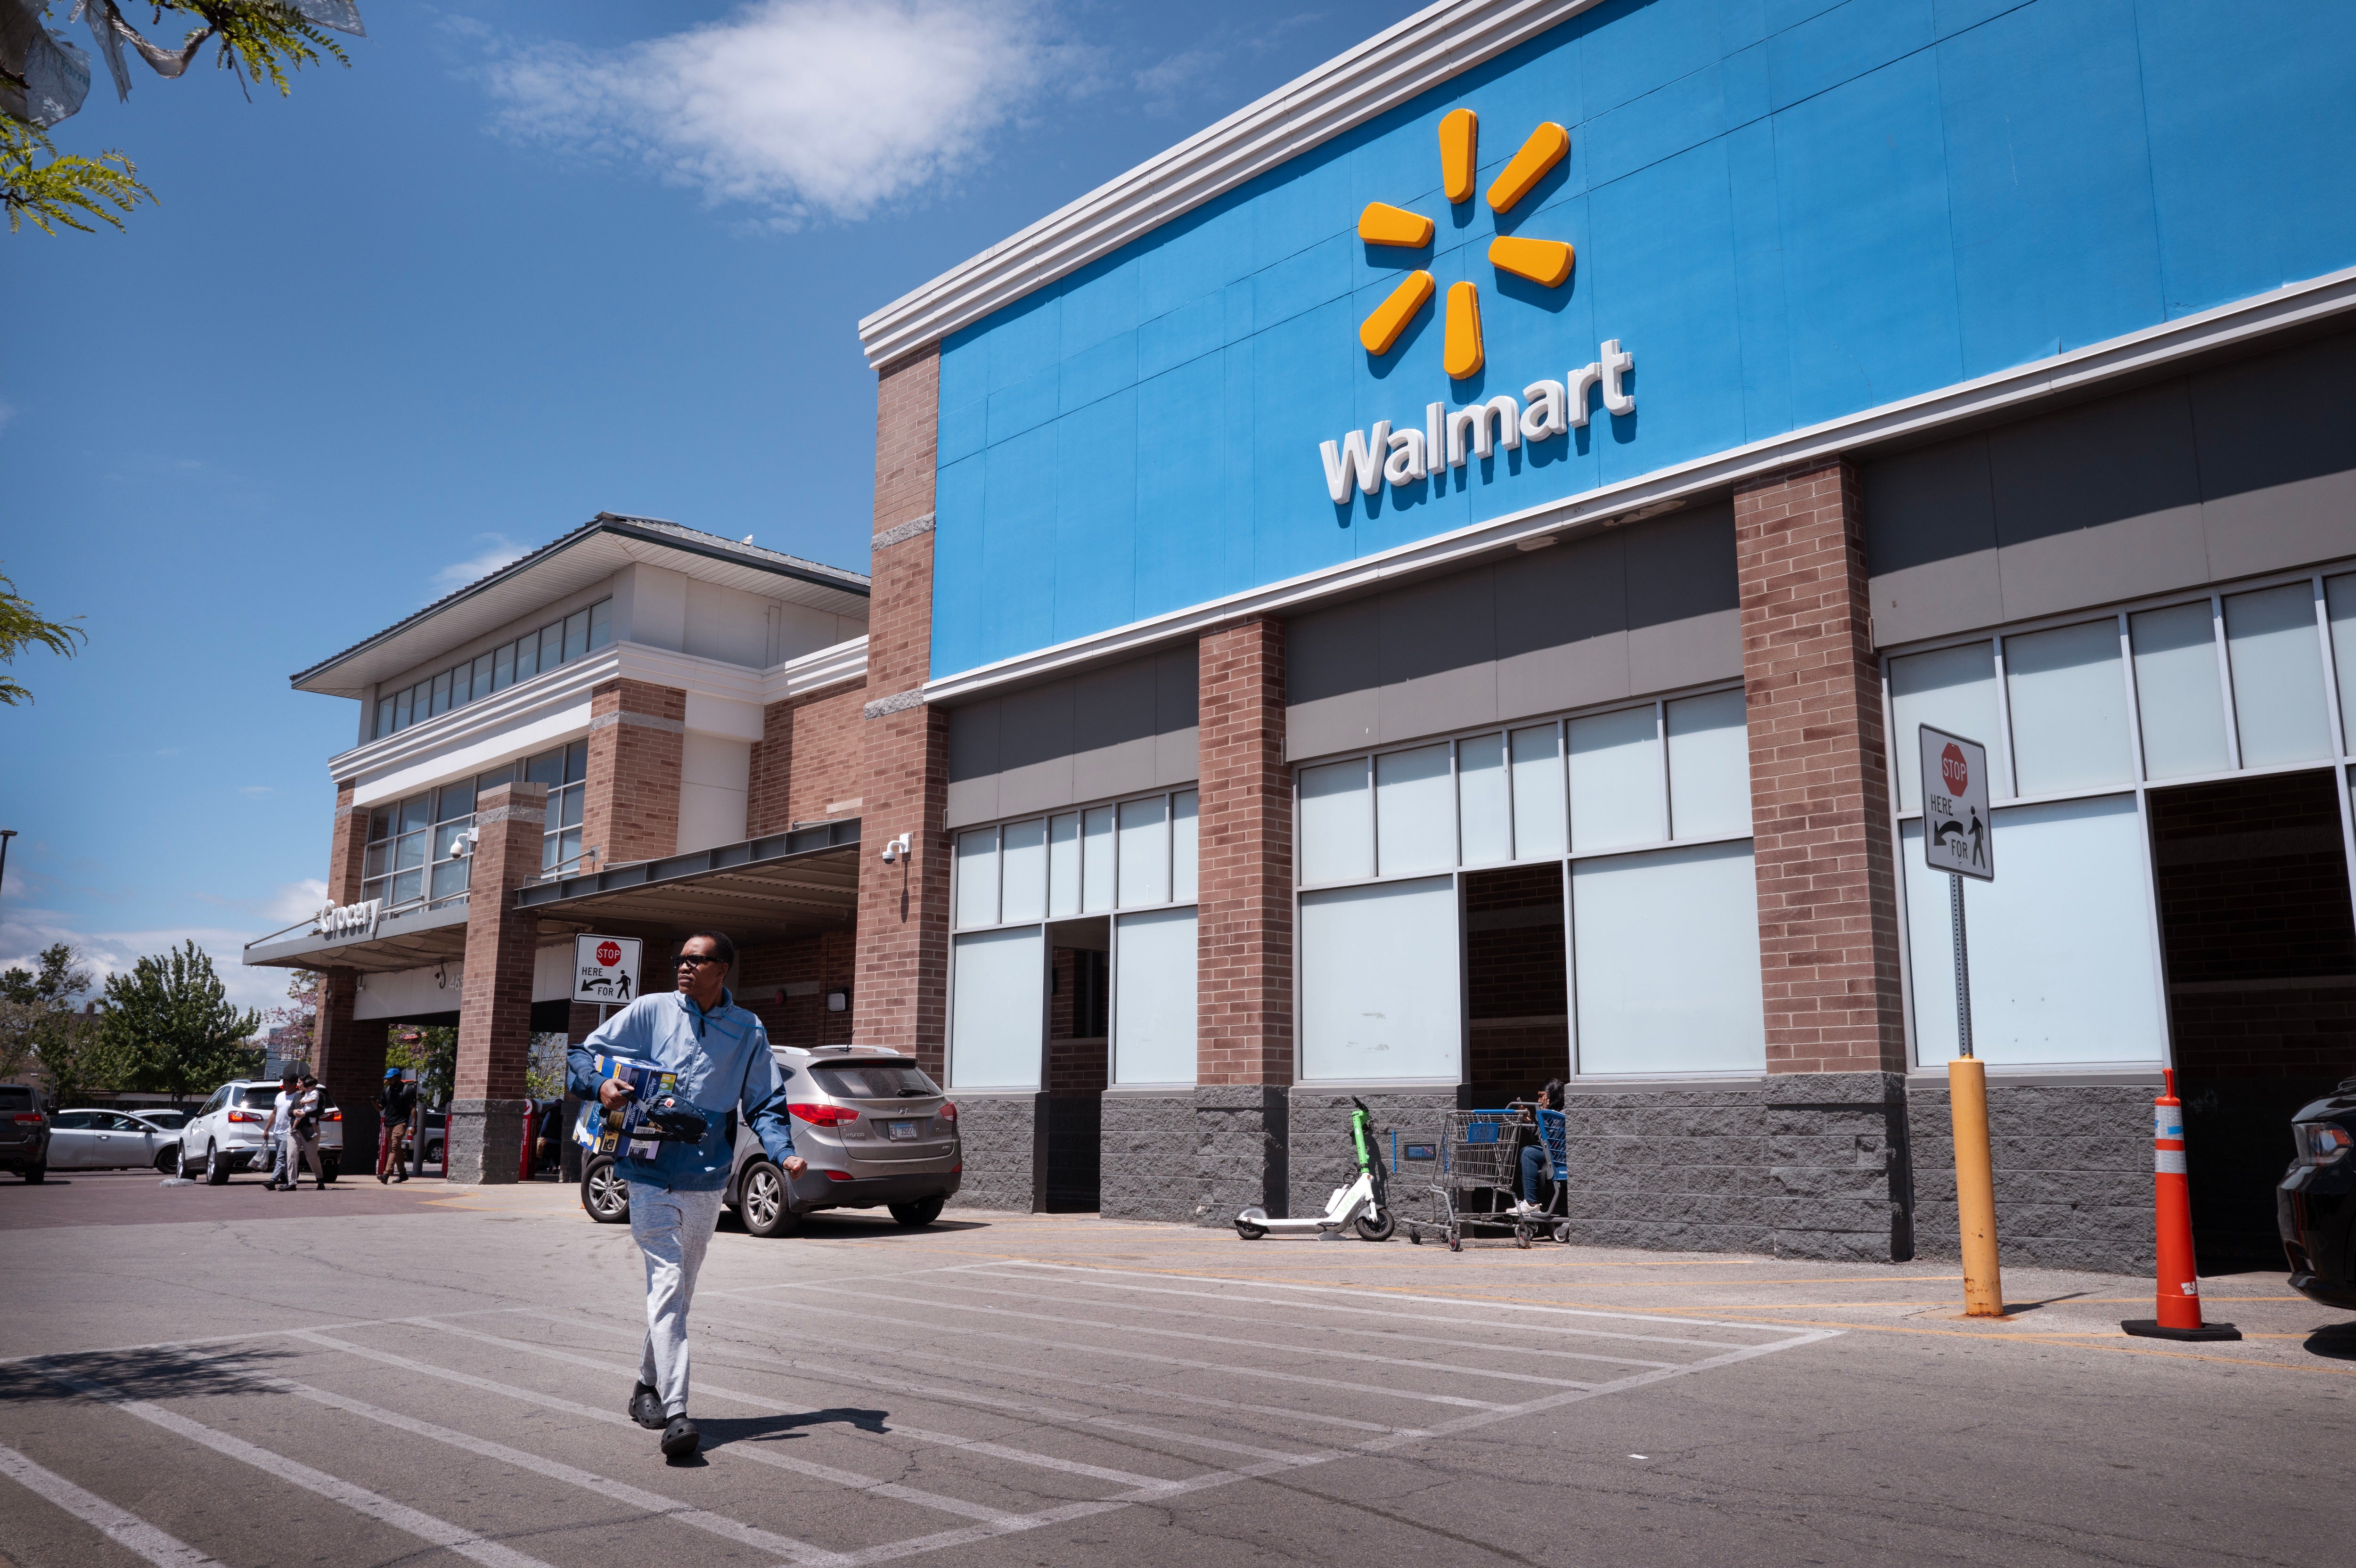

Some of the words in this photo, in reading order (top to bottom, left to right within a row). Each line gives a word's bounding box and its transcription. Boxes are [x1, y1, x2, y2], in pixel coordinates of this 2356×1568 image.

[1320, 339, 1635, 504] Walmart
[1943, 758, 1966, 781] STOP
[1931, 793, 1953, 816] HERE
[1951, 839, 1968, 859] FOR
[320, 898, 383, 934] Grocery
[597, 948, 620, 959] STOP
[582, 967, 603, 977] HERE
[597, 987, 614, 996] FOR
[647, 1078, 657, 1098] always
[629, 1104, 639, 1123] lways
[900, 1126, 916, 1136] 39227
